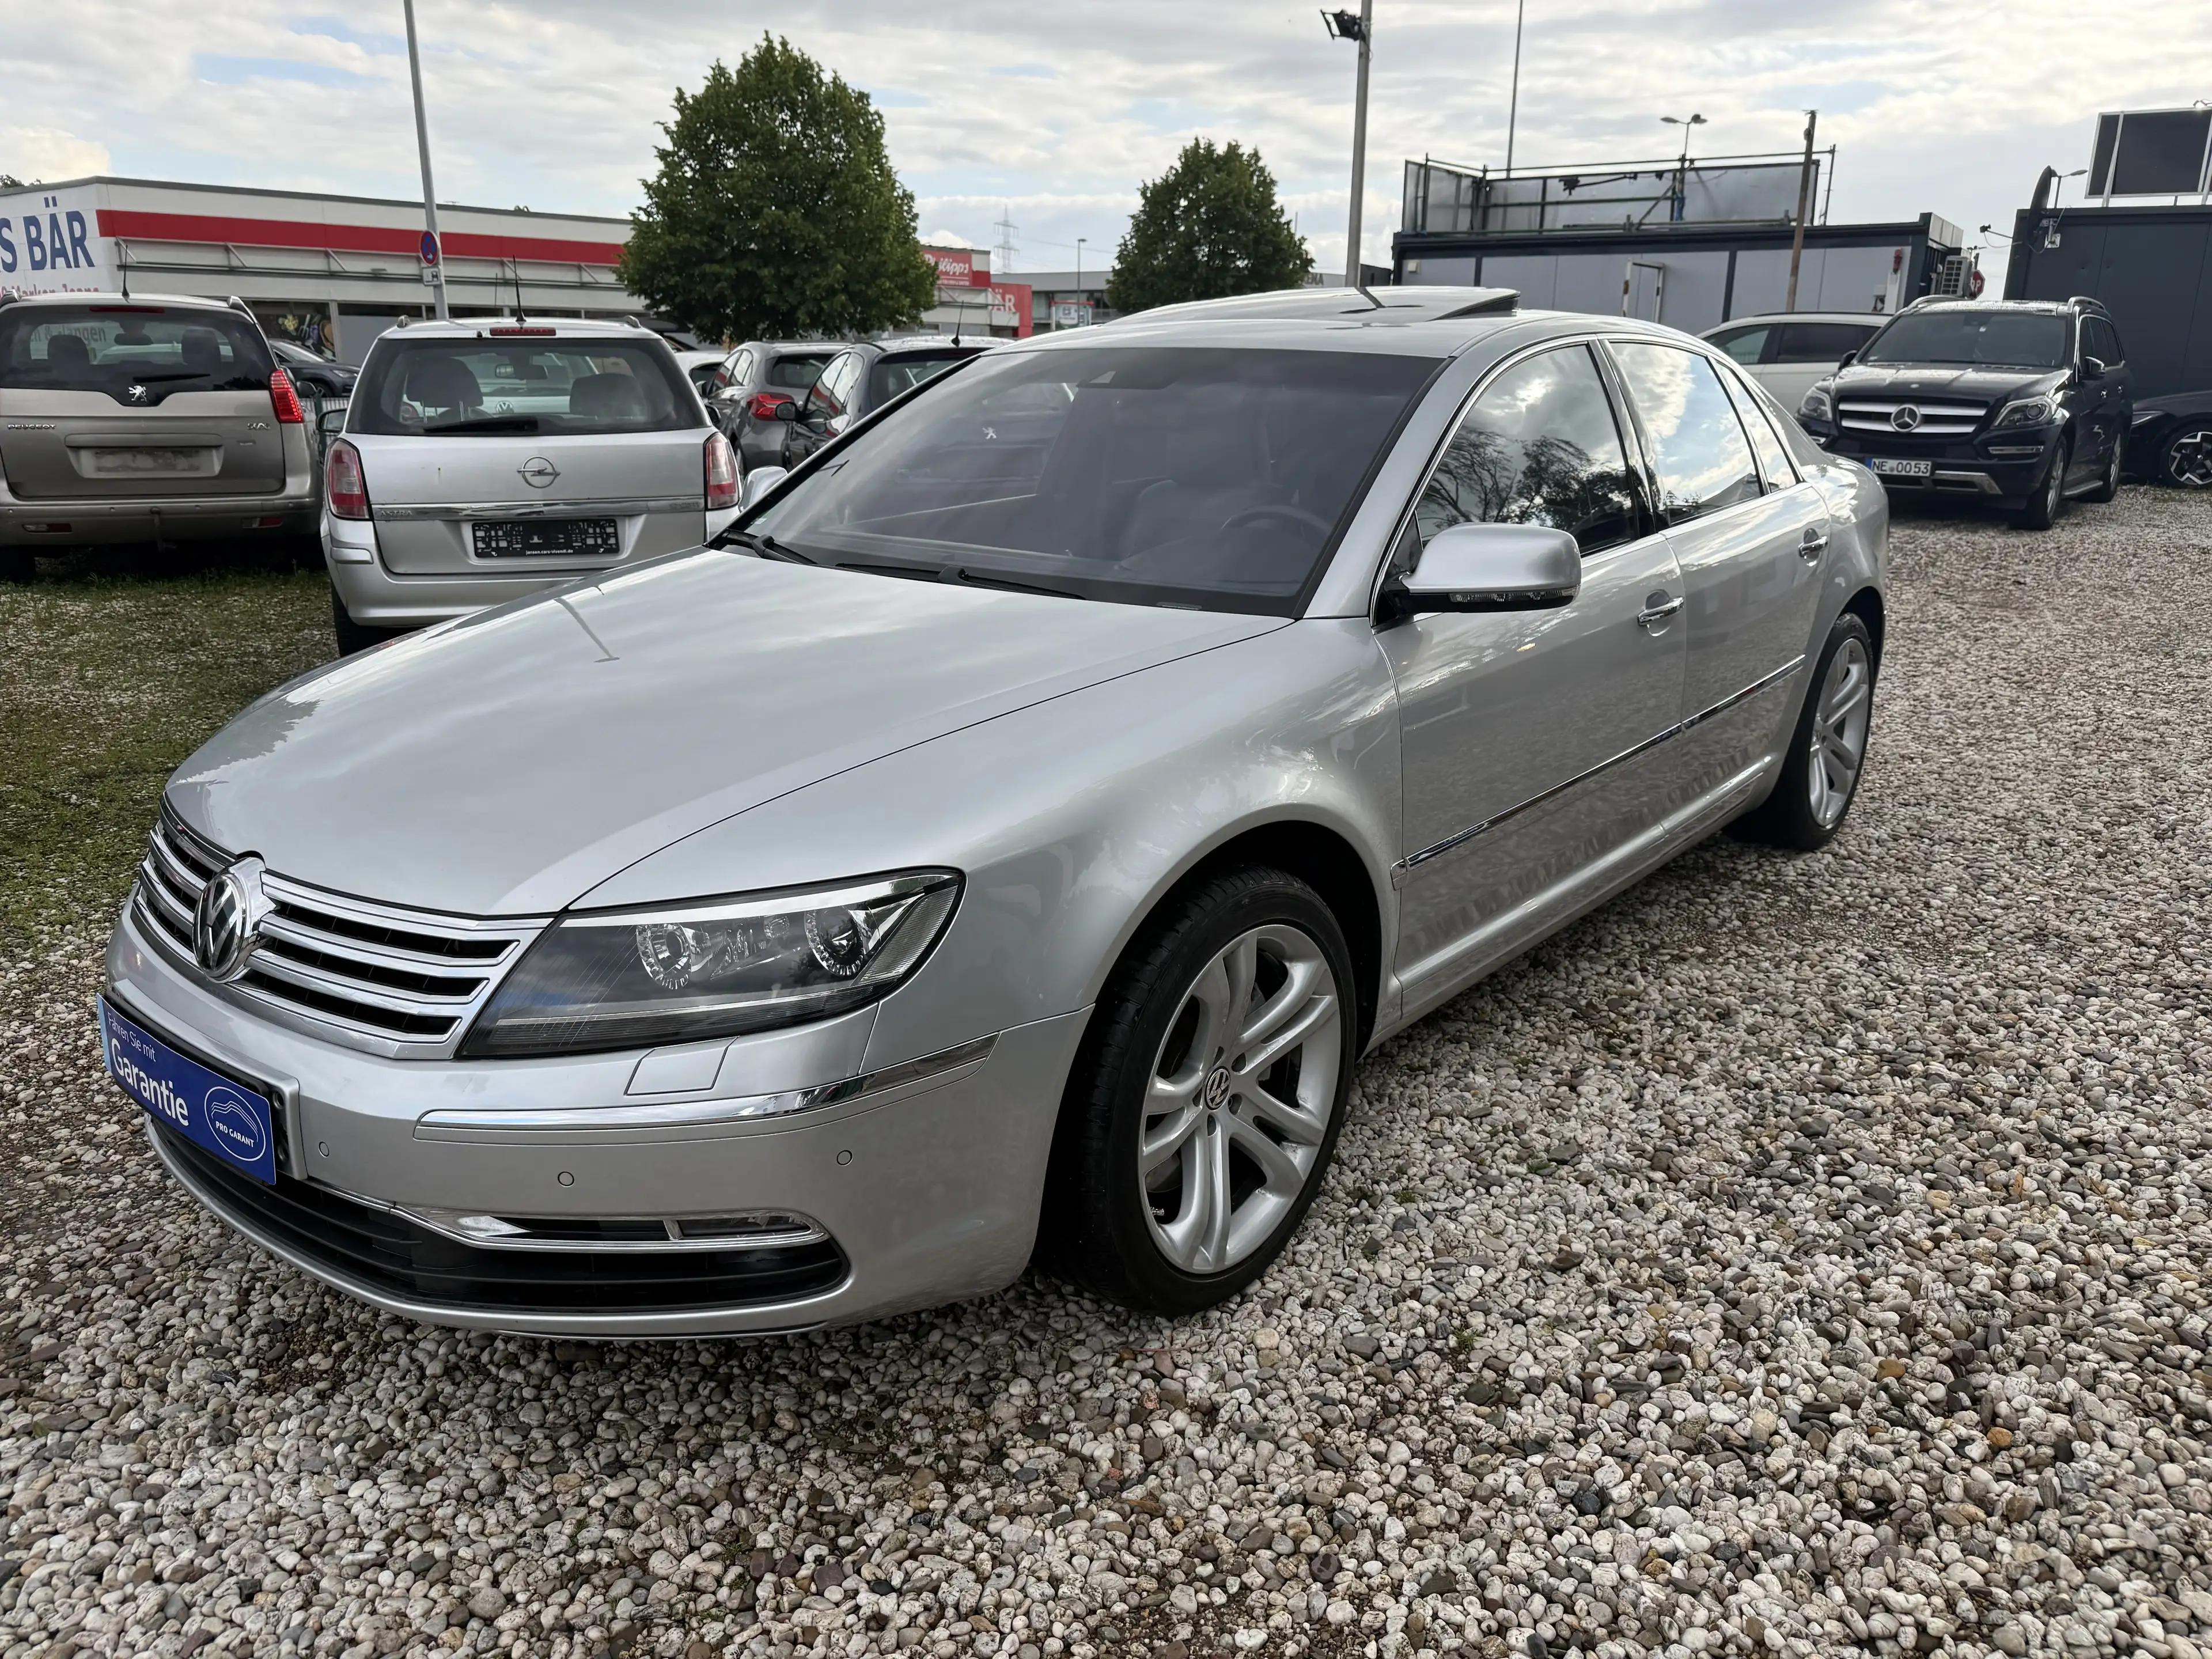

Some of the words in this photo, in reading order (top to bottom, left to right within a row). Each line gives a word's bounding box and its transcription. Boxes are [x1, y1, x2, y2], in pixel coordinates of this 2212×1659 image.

[0, 217, 17, 272] S
[23, 196, 95, 270] BÄR
[1970, 280, 1982, 293] OP
[990, 289, 1016, 312] ÄR
[1873, 460, 1888, 472] NE
[108, 1012, 129, 1043] Fahren
[130, 1031, 141, 1051] Sie
[143, 1043, 156, 1062] mit
[111, 1038, 189, 1126] Garantie
[215, 1121, 228, 1134] PRO
[229, 1128, 254, 1147] GARANT
